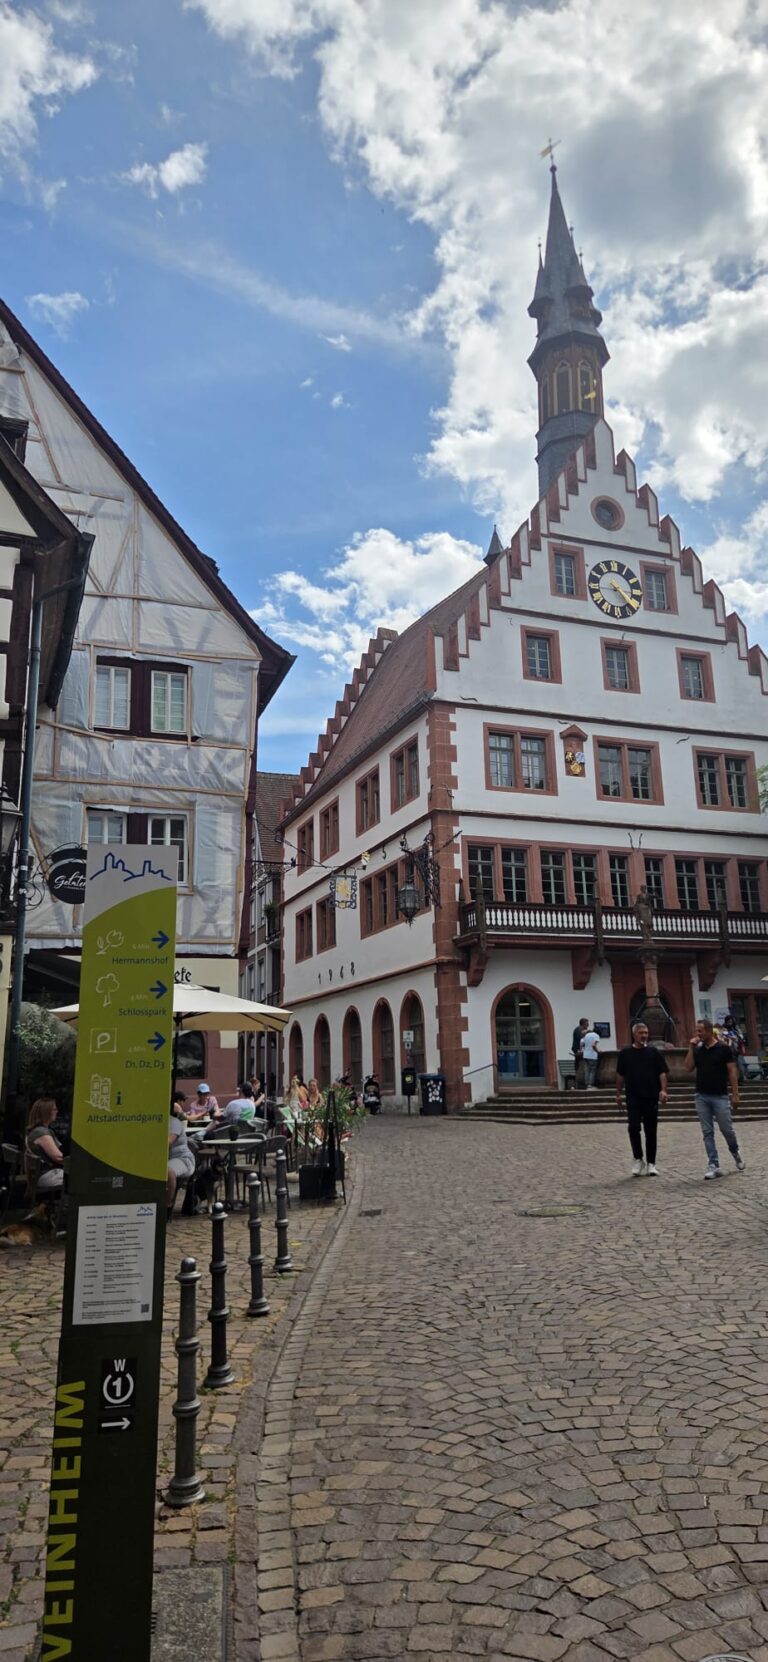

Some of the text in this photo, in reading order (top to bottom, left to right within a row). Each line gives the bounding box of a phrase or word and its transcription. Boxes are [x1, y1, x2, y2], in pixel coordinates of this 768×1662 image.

[112, 956, 168, 965] Hermannshof
[318, 961, 355, 984] 1968
[118, 1008, 166, 1017] Schlosspark
[153, 1059, 165, 1069] D3
[87, 1113, 163, 1123] Altstadtrundgang
[114, 1358, 126, 1372] W
[112, 1377, 122, 1397] 1
